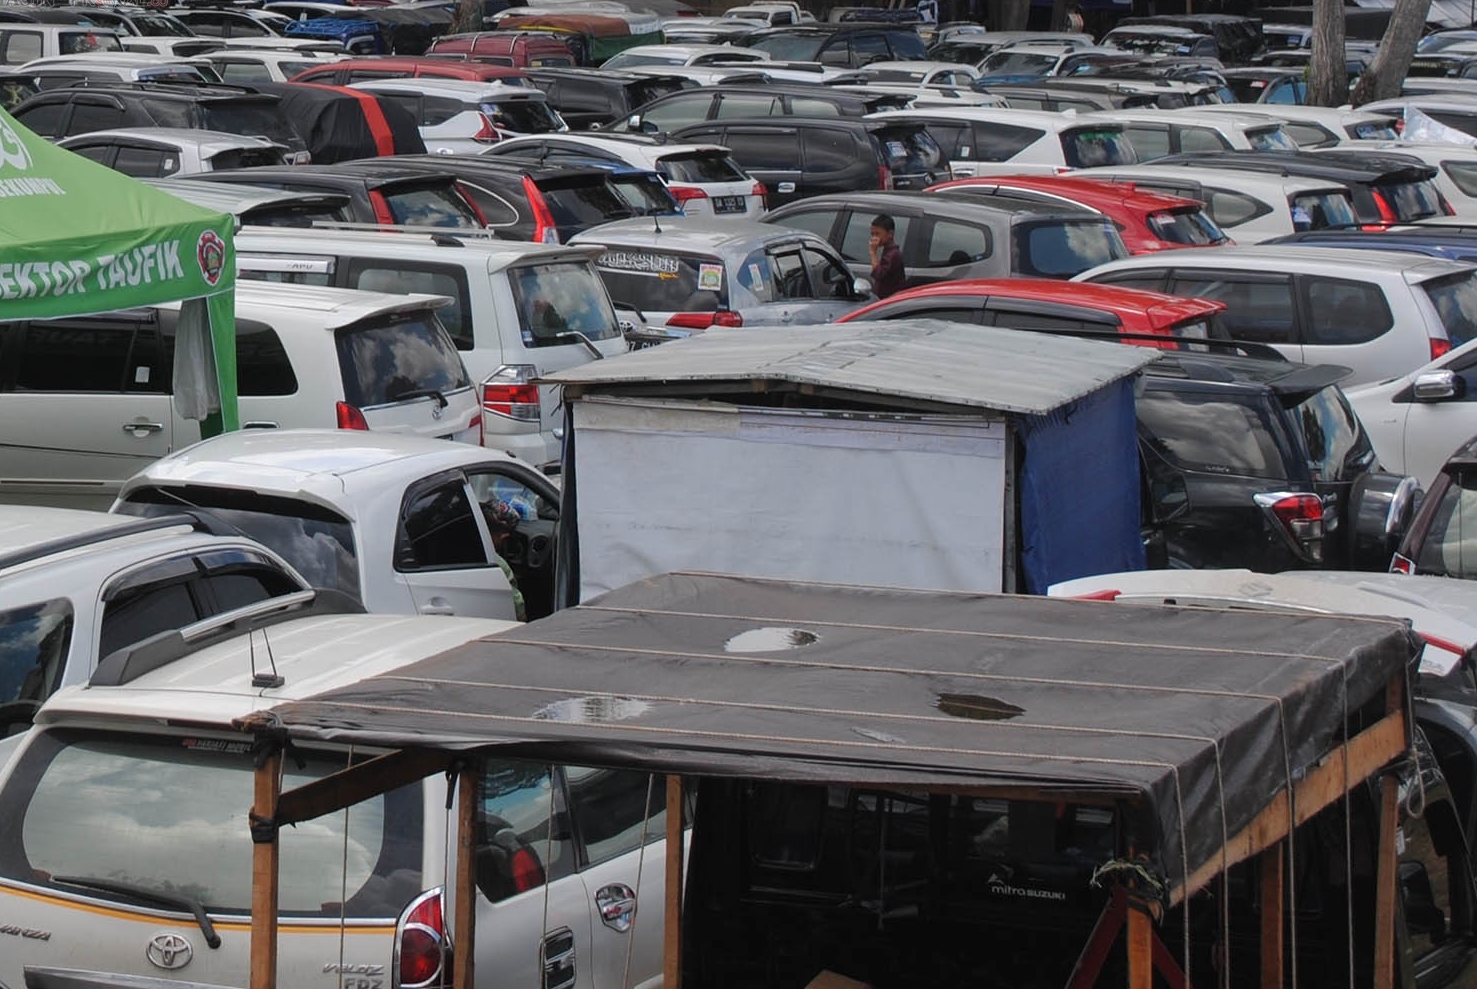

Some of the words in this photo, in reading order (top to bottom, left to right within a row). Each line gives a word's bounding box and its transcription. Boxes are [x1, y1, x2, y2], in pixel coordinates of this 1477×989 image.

[96, 239, 185, 290] TAUFIK
[991, 885, 1025, 896] mitra
[1027, 889, 1066, 900] SUZUKI
